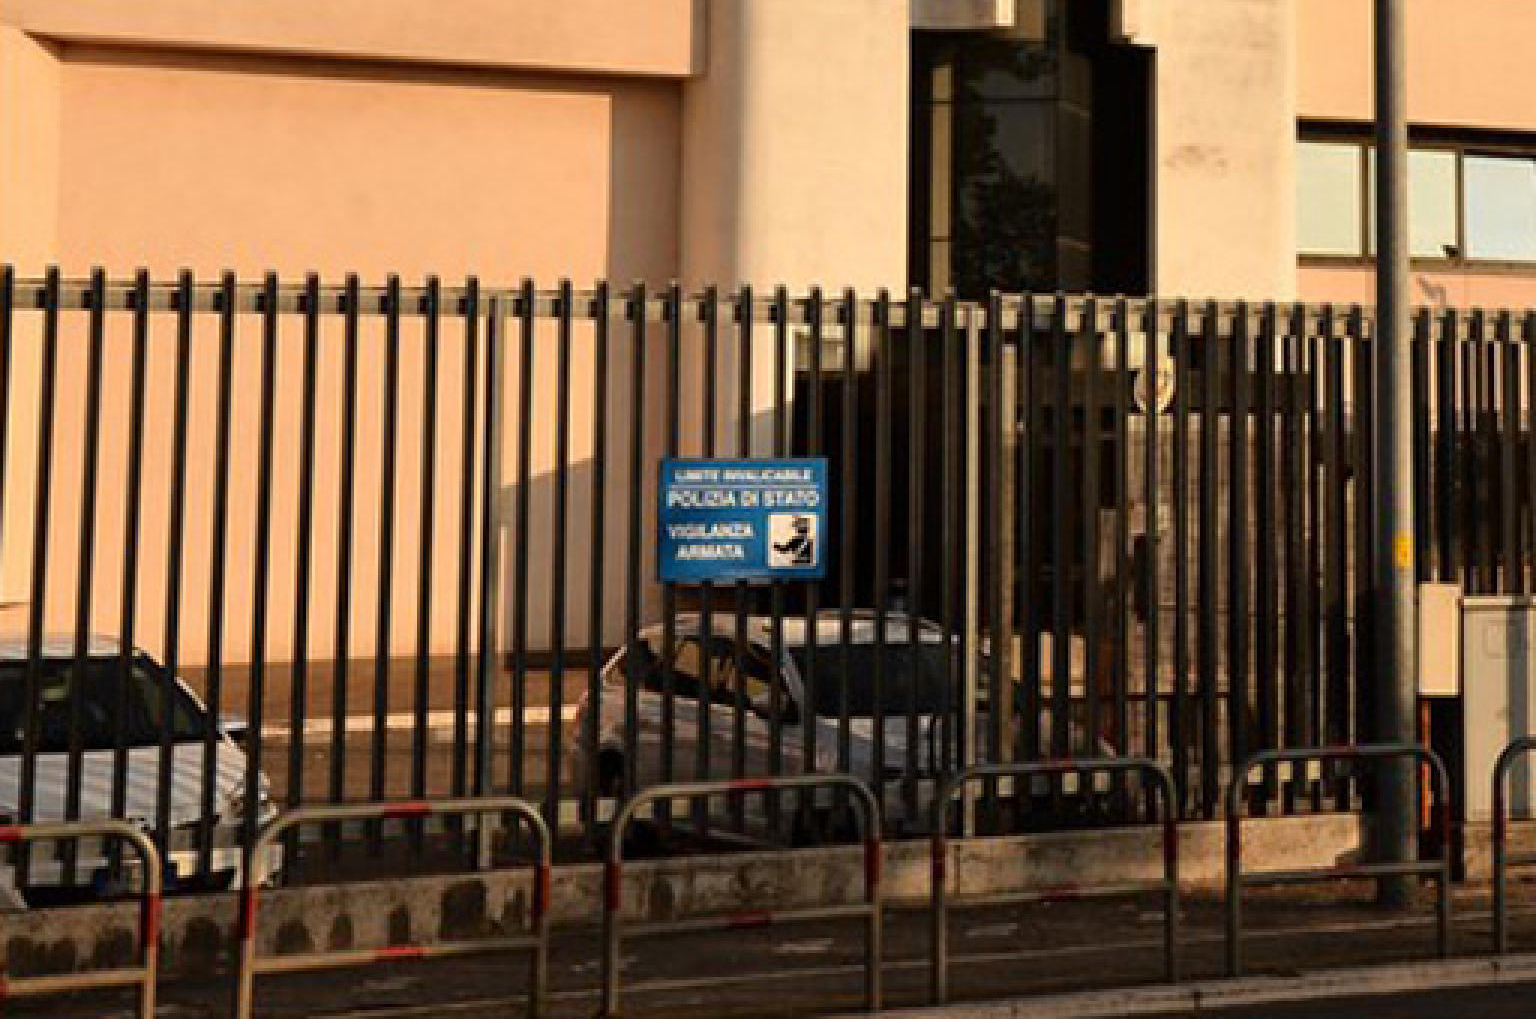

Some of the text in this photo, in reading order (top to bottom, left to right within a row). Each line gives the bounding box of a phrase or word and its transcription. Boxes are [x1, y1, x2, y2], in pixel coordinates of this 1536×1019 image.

[667, 490, 819, 508] POLIZIA DI STATO
[668, 523, 755, 539] VIGILANZA
[676, 544, 745, 560] ARMATA
